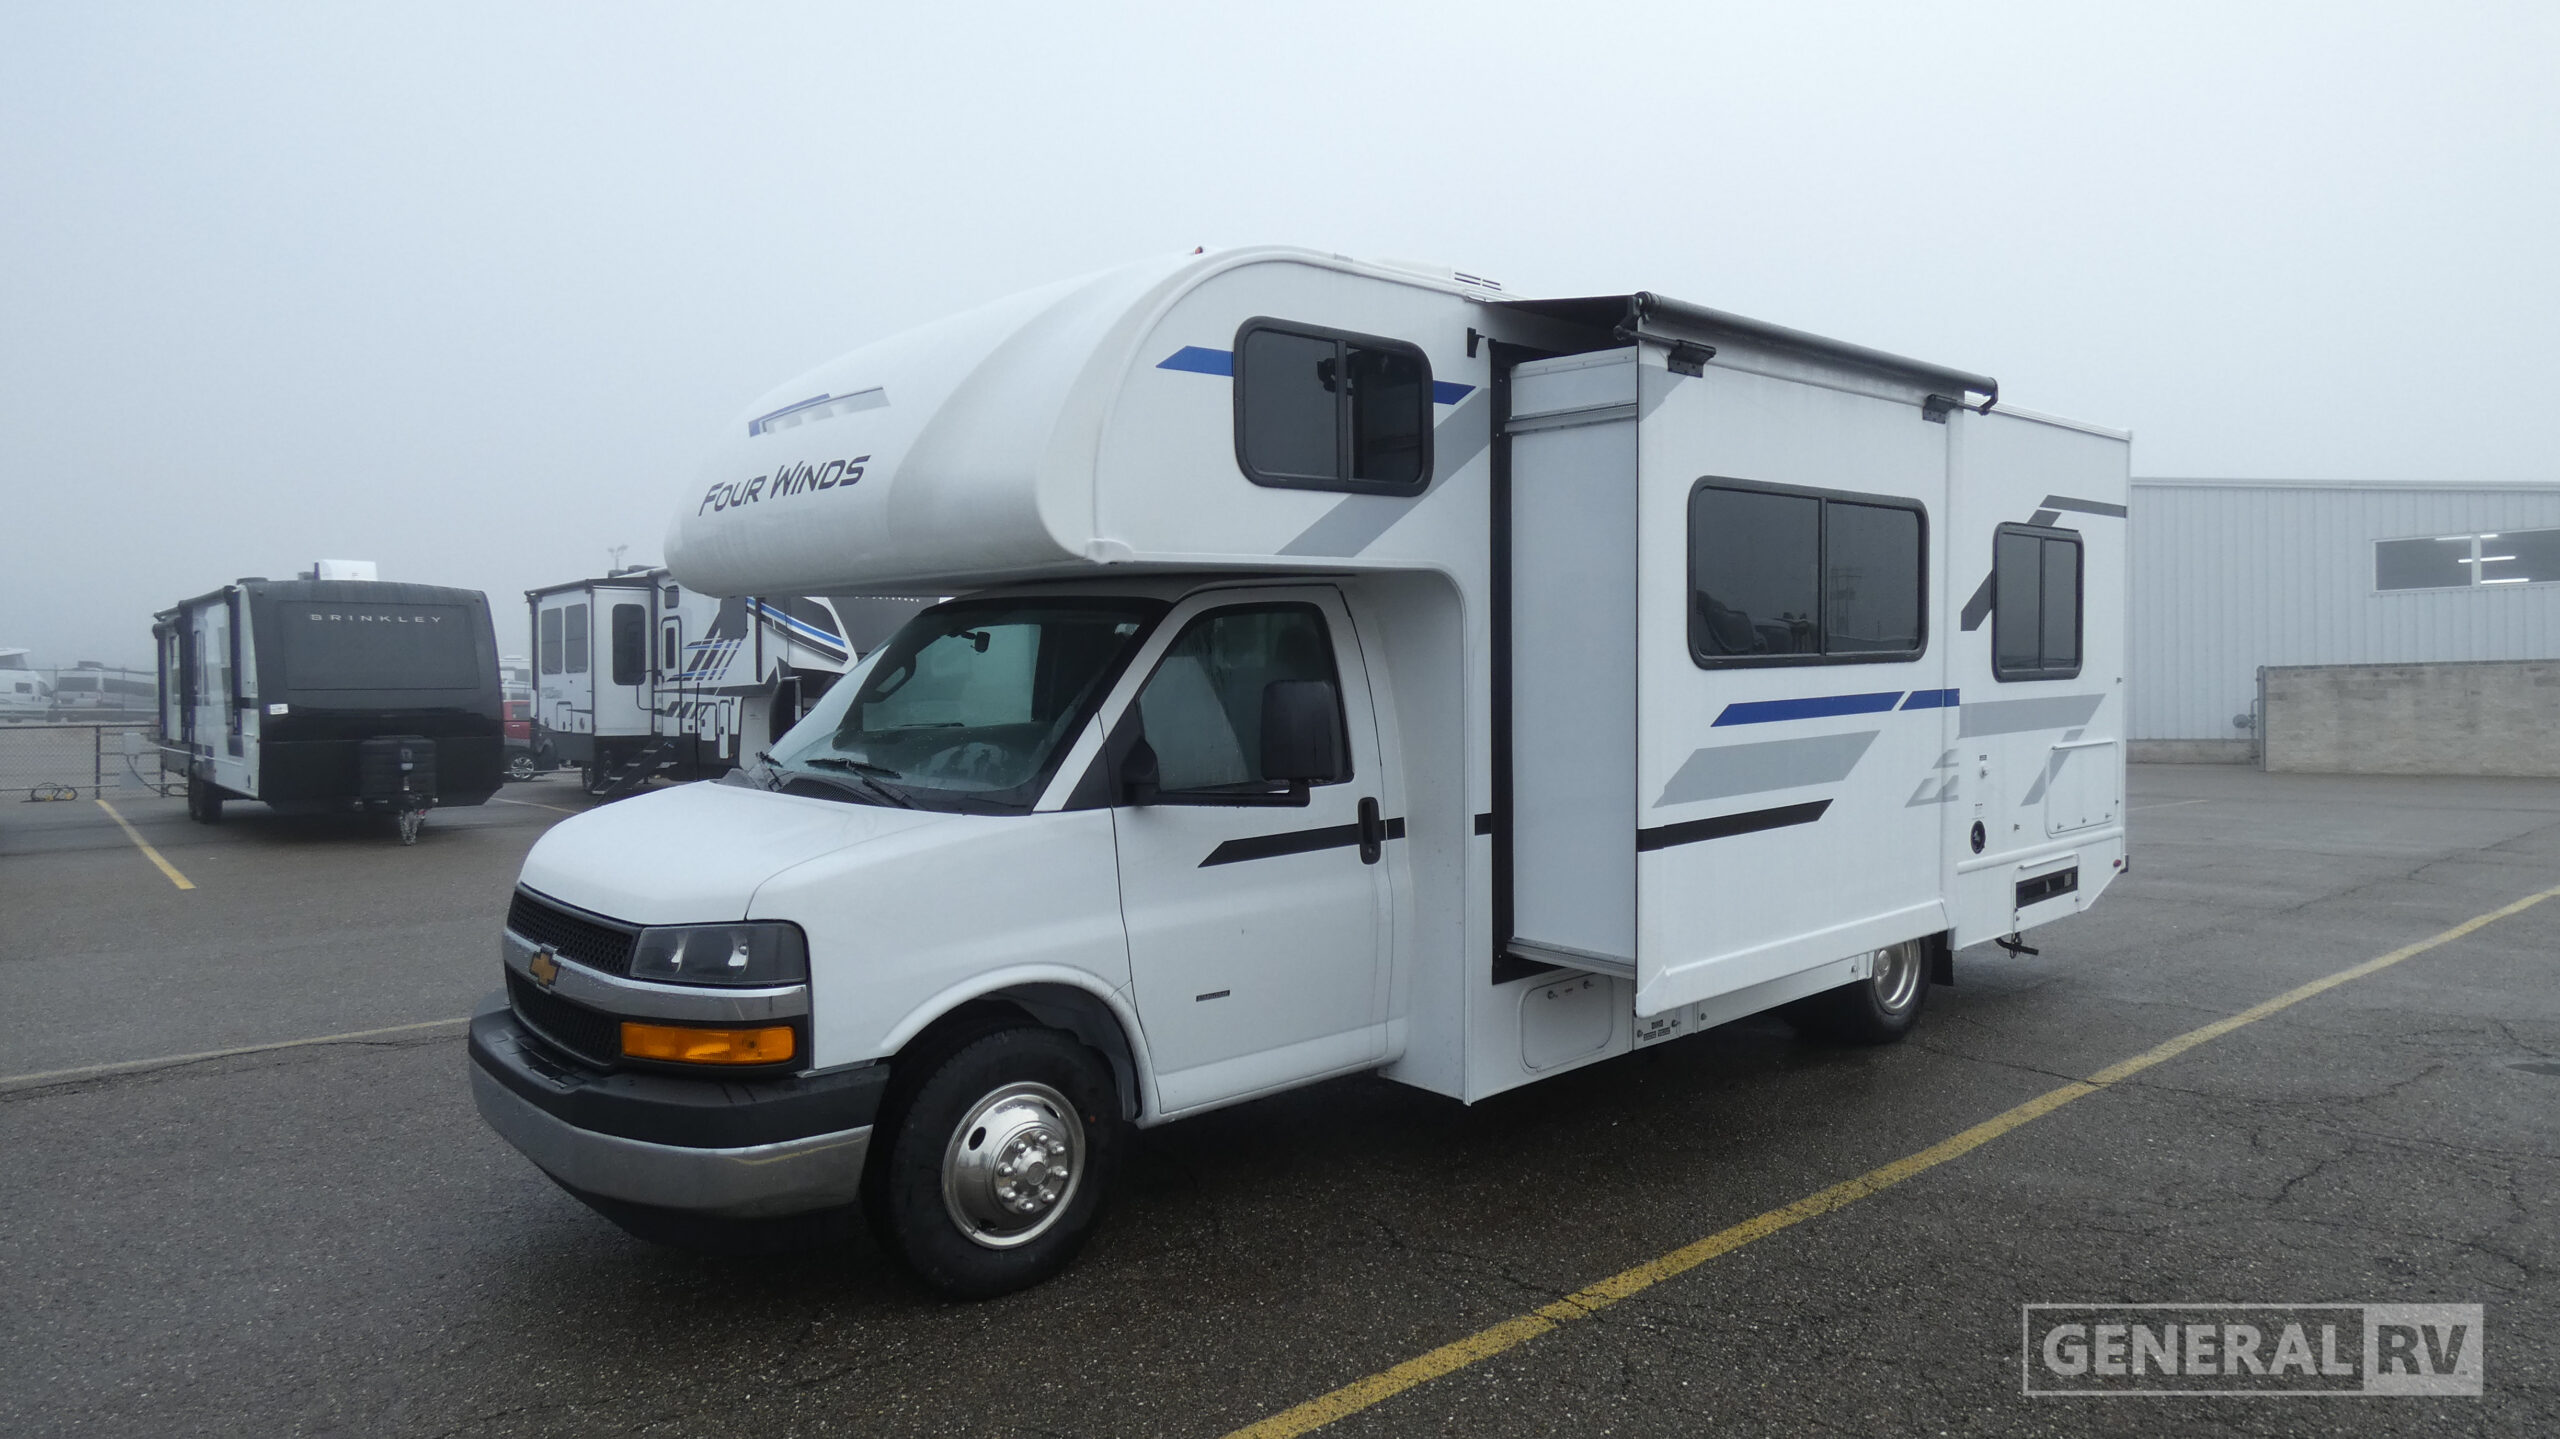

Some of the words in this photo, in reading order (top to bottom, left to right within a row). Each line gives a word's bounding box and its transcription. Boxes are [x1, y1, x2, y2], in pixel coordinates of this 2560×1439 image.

[698, 475, 767, 517] FOUR
[770, 454, 871, 500] WINDS
[309, 614, 441, 623] BRINKLEY
